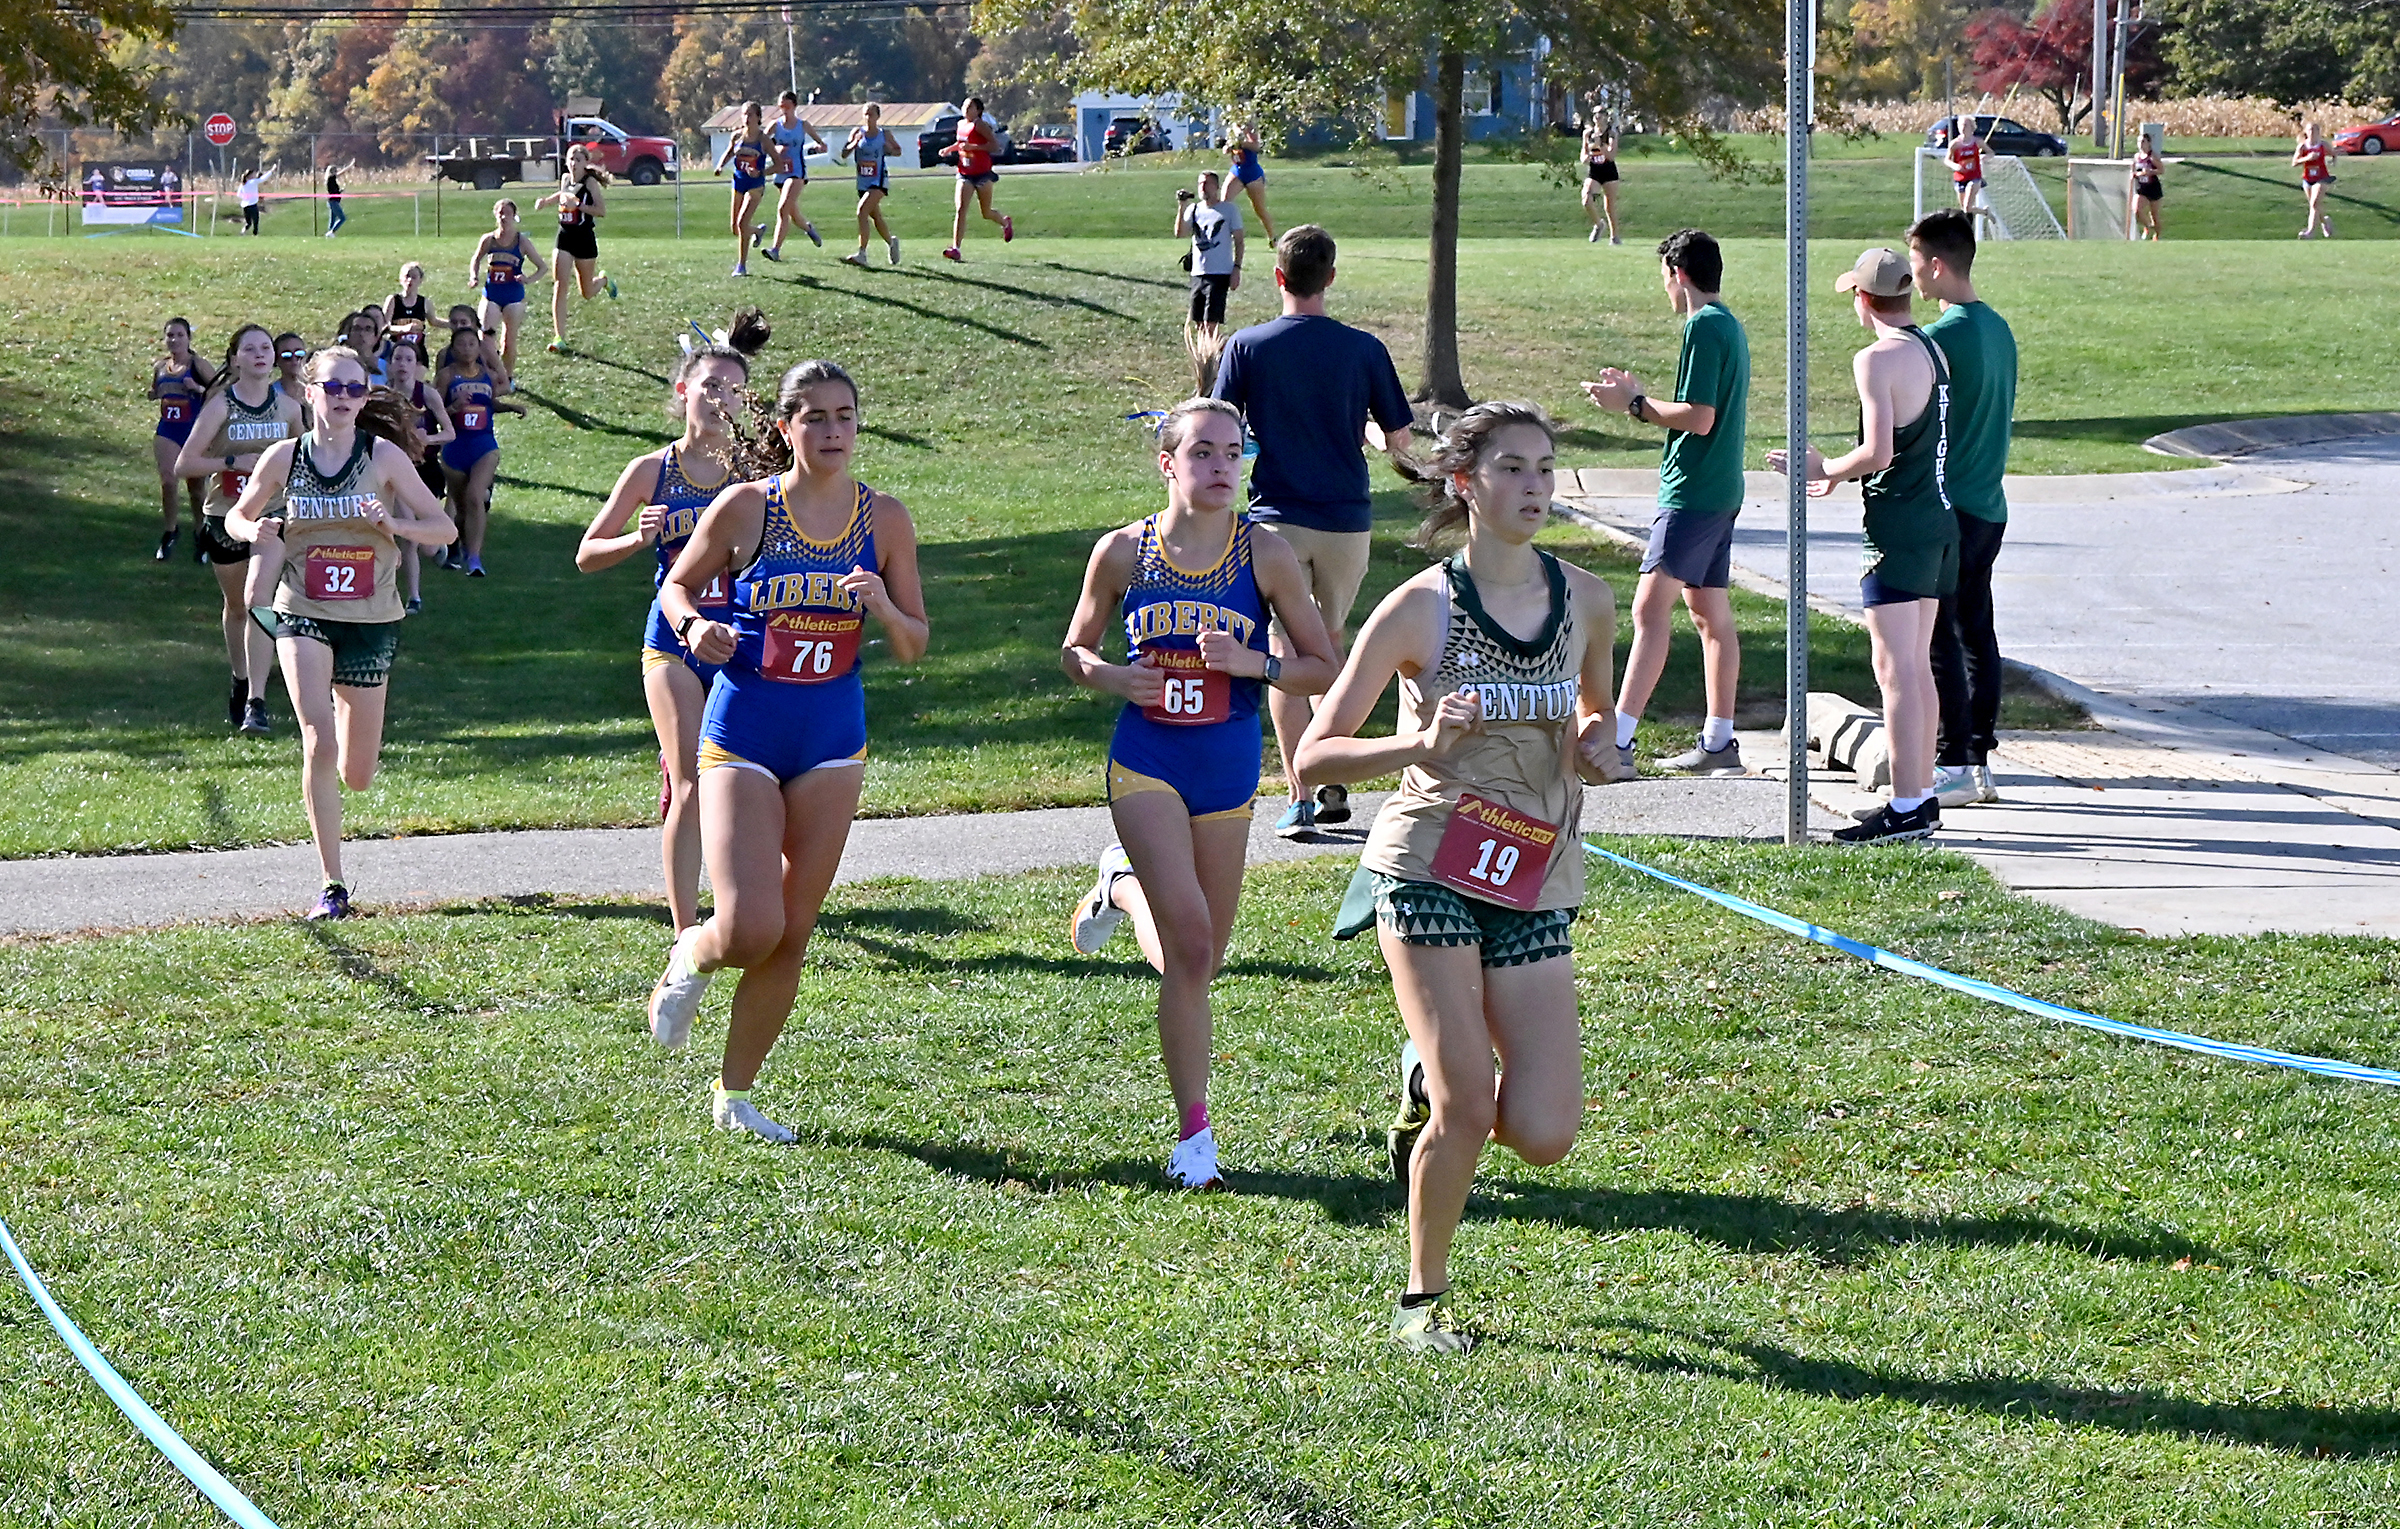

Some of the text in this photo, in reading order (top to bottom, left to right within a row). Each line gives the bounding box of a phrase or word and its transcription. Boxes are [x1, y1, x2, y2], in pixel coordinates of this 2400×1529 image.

[207, 123, 233, 135] STOP
[494, 272, 506, 281] 72
[167, 407, 180, 419] 73
[228, 422, 287, 440] CENTURY
[325, 566, 355, 592] 32
[769, 613, 838, 631] Athletic
[791, 640, 834, 674] 76
[1164, 677, 1204, 714] 65
[1457, 800, 1532, 837] Athletic
[1468, 838, 1520, 886] 19
